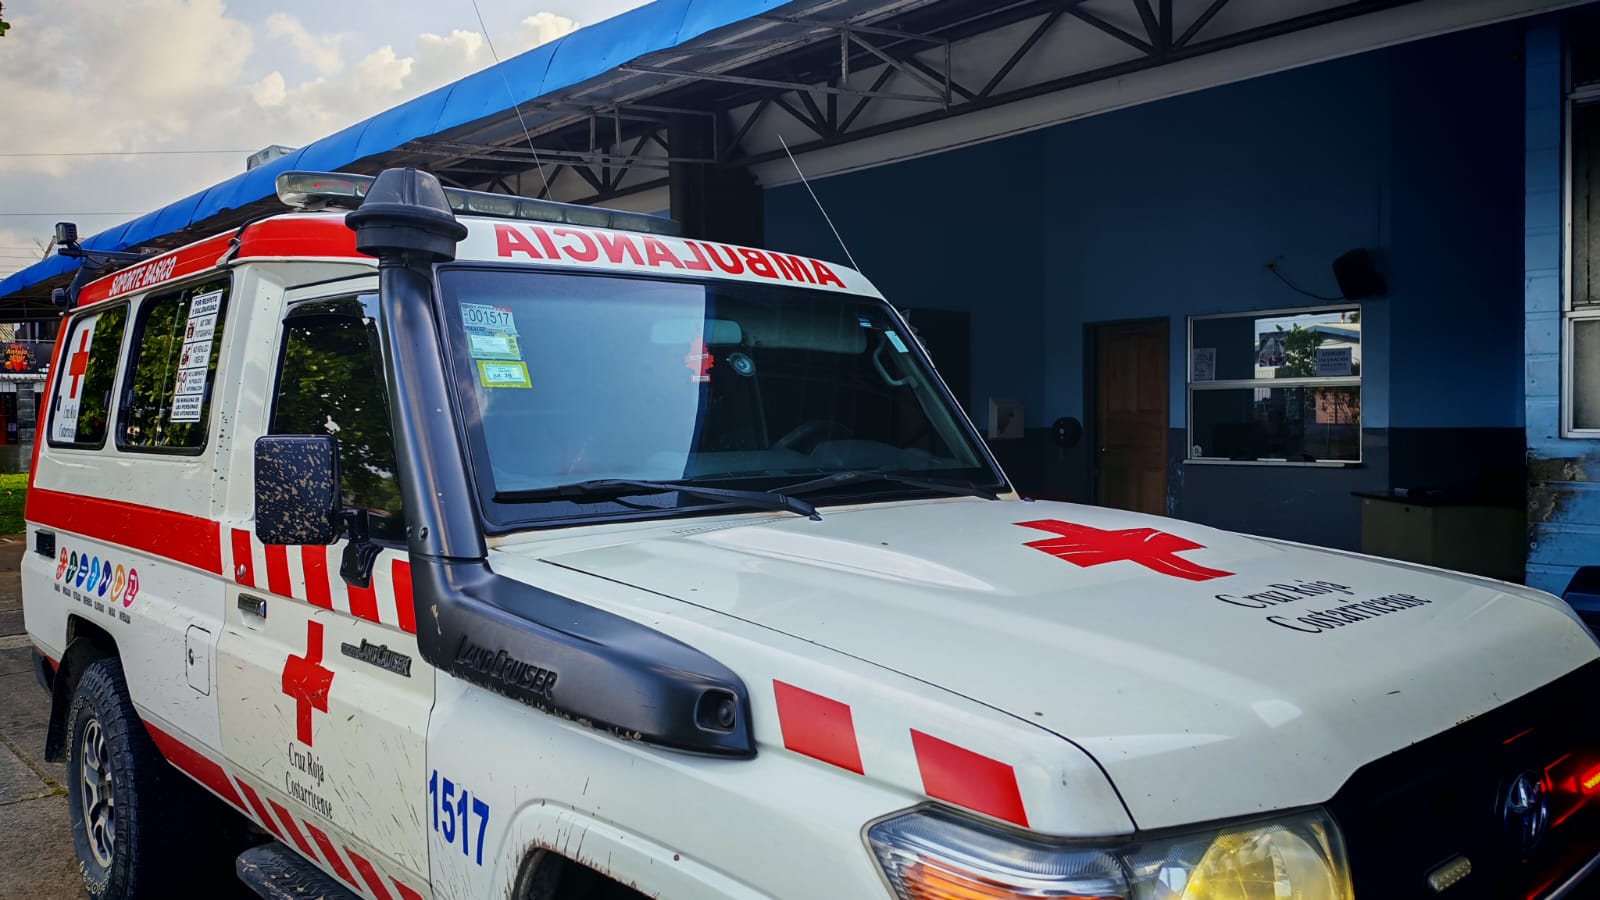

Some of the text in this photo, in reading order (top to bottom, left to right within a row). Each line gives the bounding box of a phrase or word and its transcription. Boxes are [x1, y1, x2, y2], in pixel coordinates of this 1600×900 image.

[108, 265, 147, 297] SOPORTE
[469, 308, 510, 326] 001517
[1215, 579, 1355, 609] Cruz Roja
[1266, 592, 1433, 634] Costarricense
[288, 742, 324, 788] Cruz Roja
[285, 770, 333, 820] Costarricense
[429, 769, 490, 867] 1517
